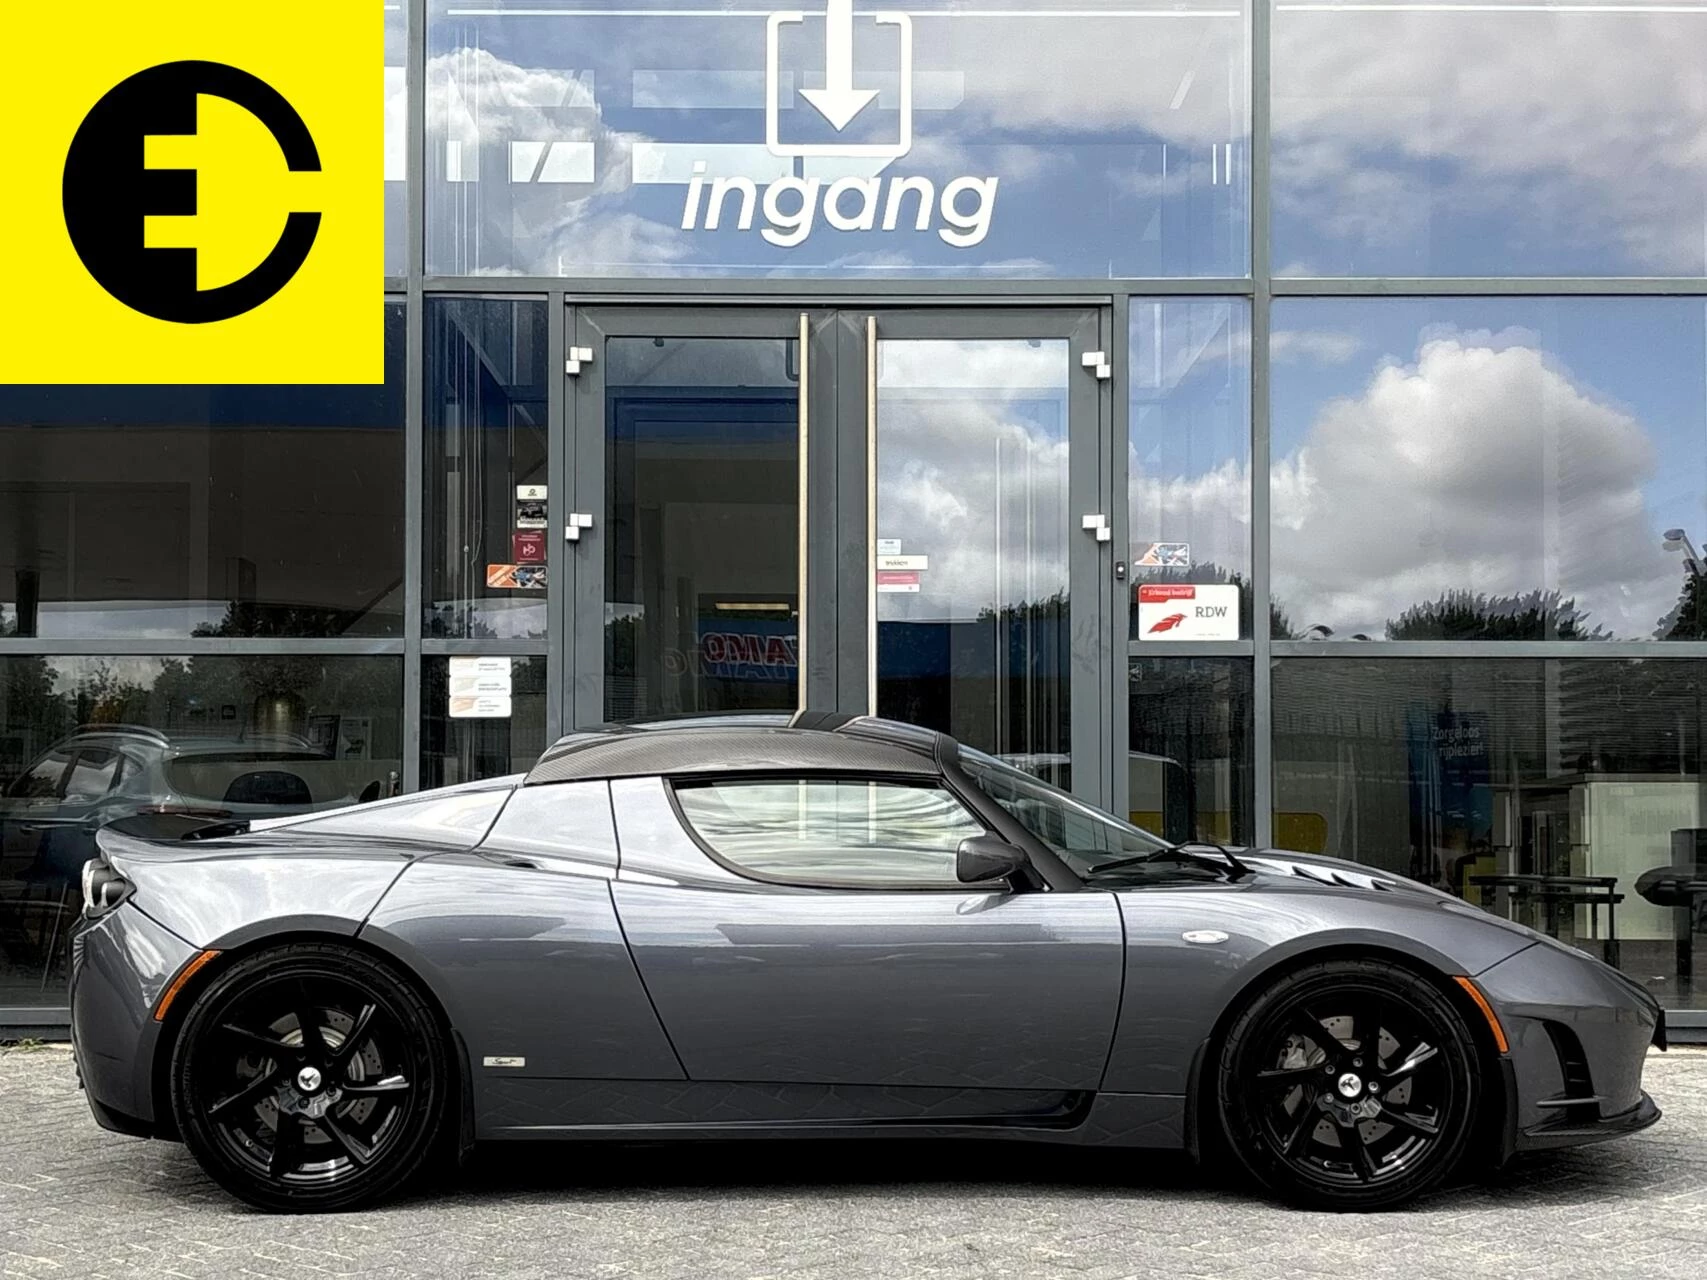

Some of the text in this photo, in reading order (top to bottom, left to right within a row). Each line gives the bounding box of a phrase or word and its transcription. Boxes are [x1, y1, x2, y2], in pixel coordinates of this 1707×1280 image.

[681, 160, 999, 248] ingang
[1195, 606, 1228, 618] RDW
[1432, 725, 1480, 743] Zorgeloos
[1439, 743, 1484, 760] rijplezier!
